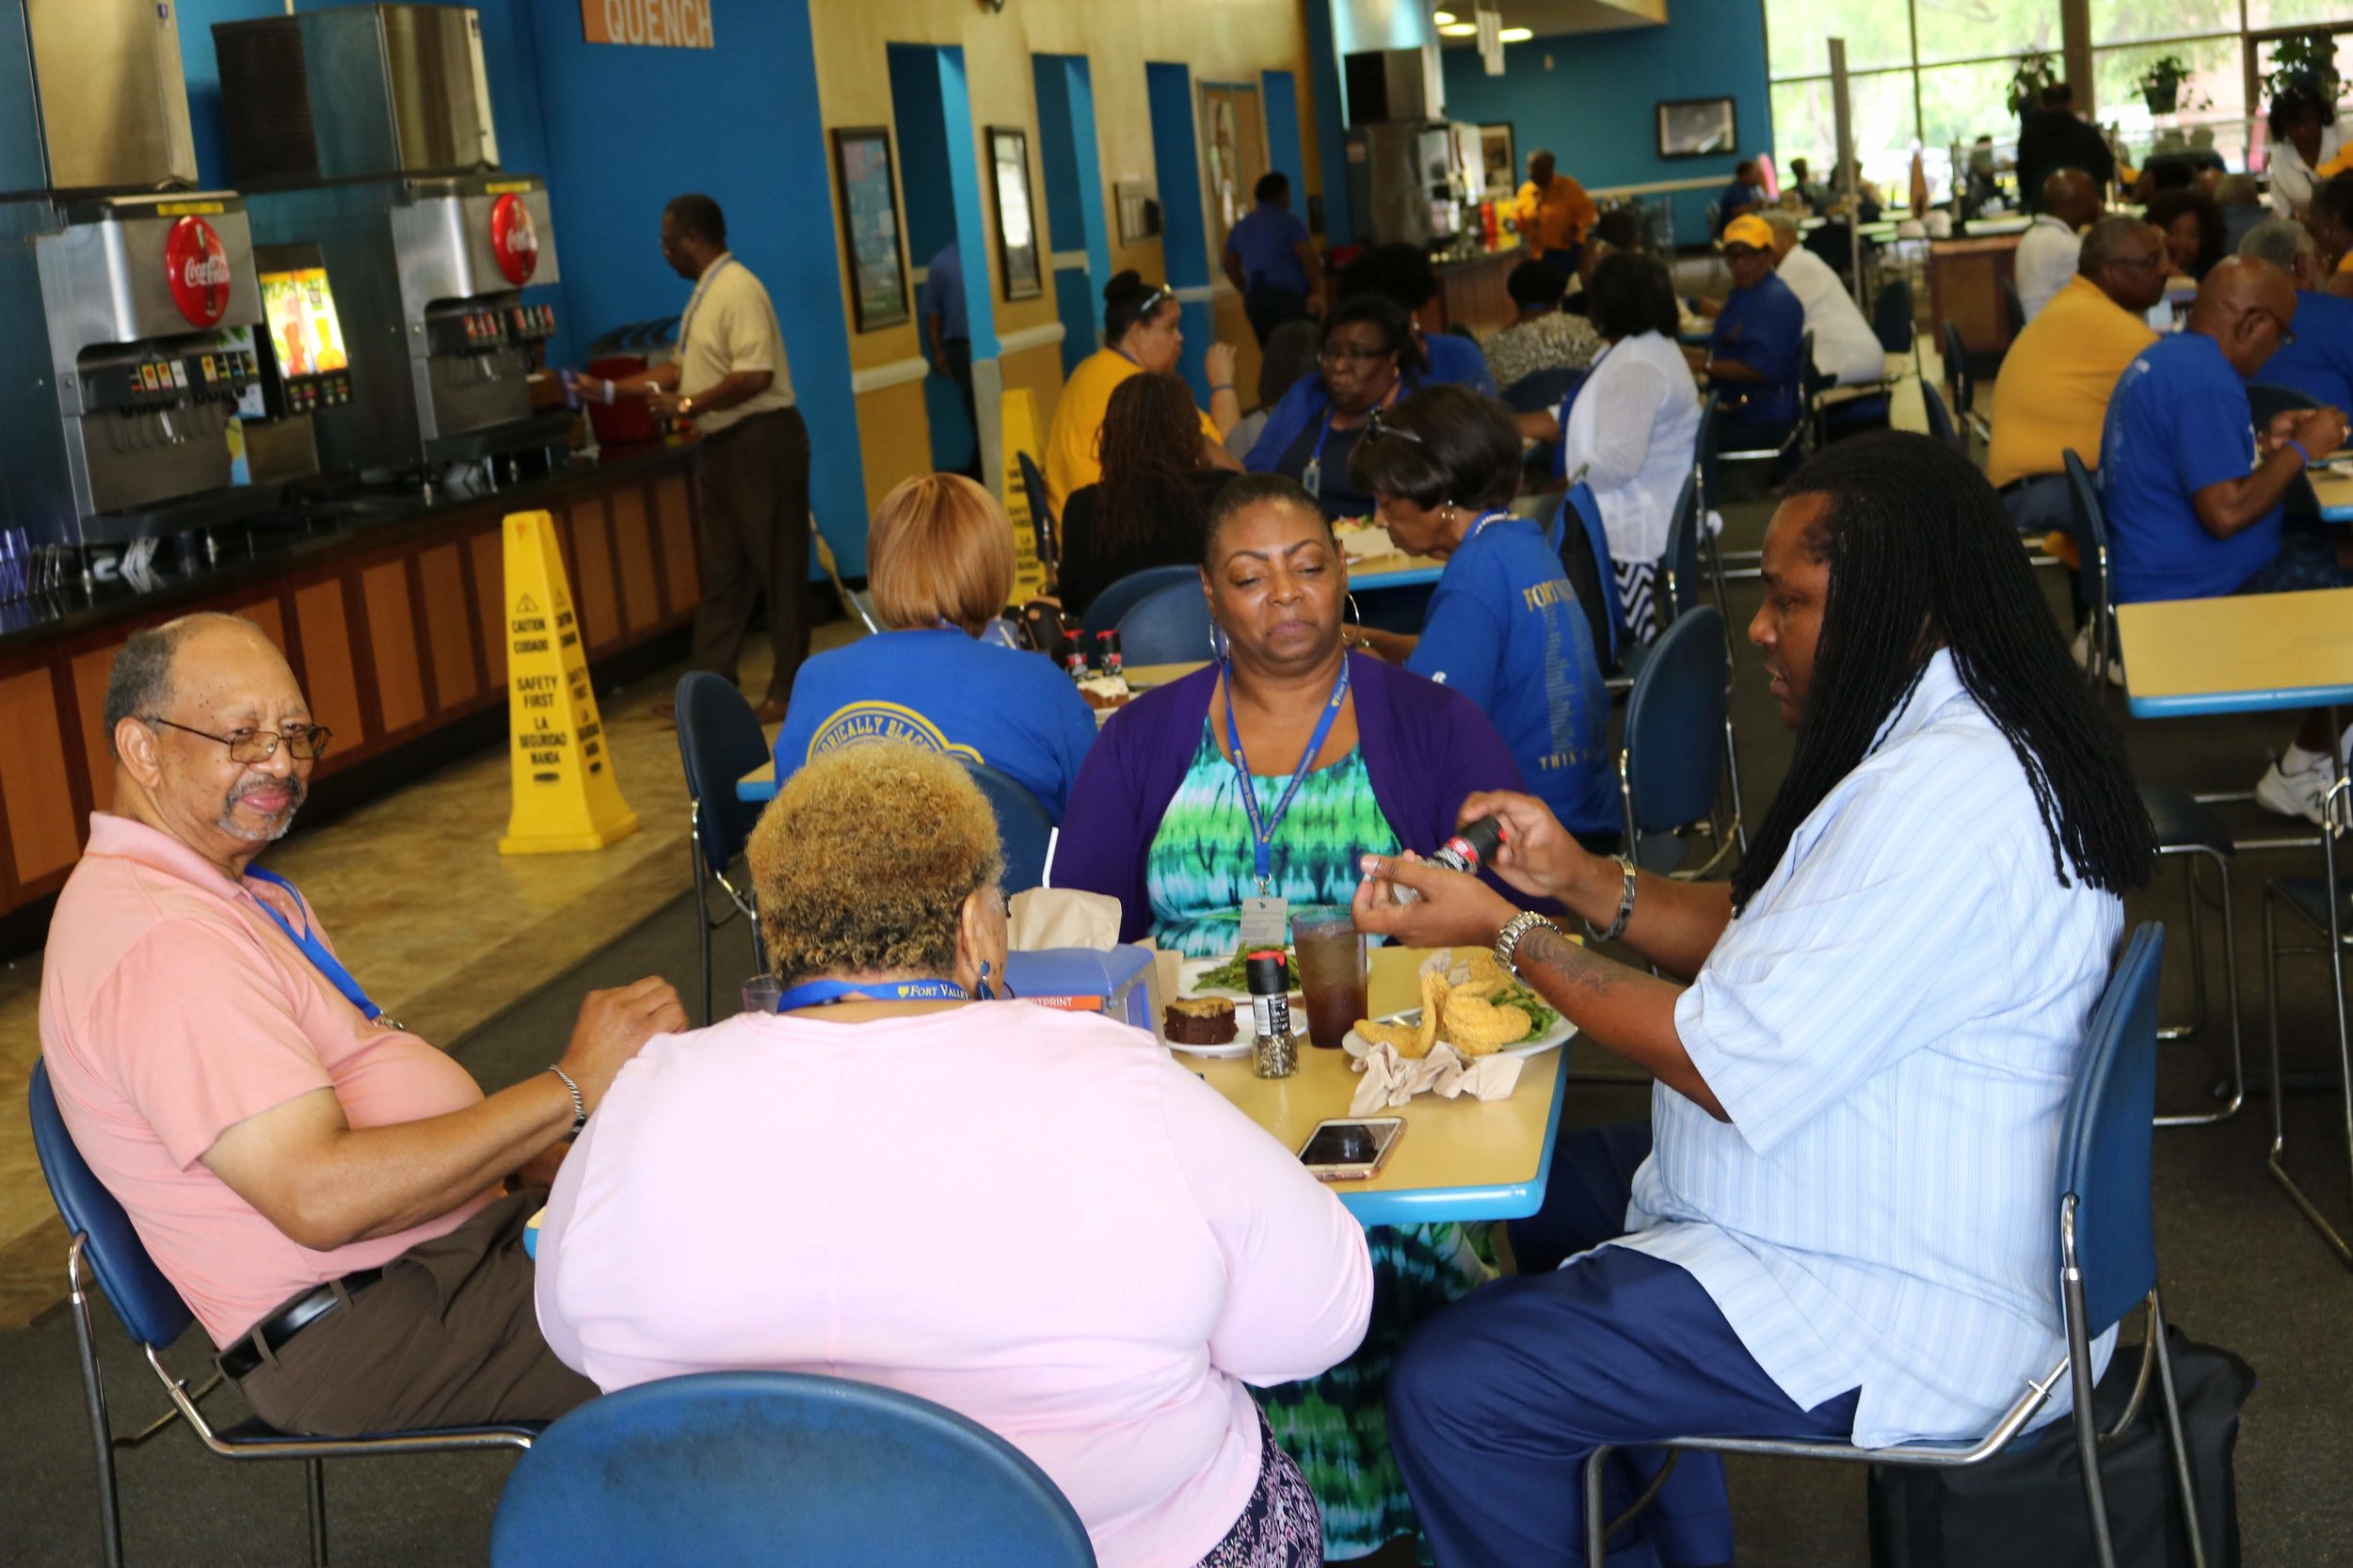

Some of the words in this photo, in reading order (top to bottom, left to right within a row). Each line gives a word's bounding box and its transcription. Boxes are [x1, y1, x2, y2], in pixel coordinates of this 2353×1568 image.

[603, 0, 715, 49] QUENCH
[517, 676, 557, 691] SAFETY
[523, 693, 554, 708] FIRST
[534, 716, 549, 730] LA
[821, 716, 883, 752] ORICALLY
[910, 984, 938, 998] FORT
[1032, 997, 1073, 1007] TPRINT
